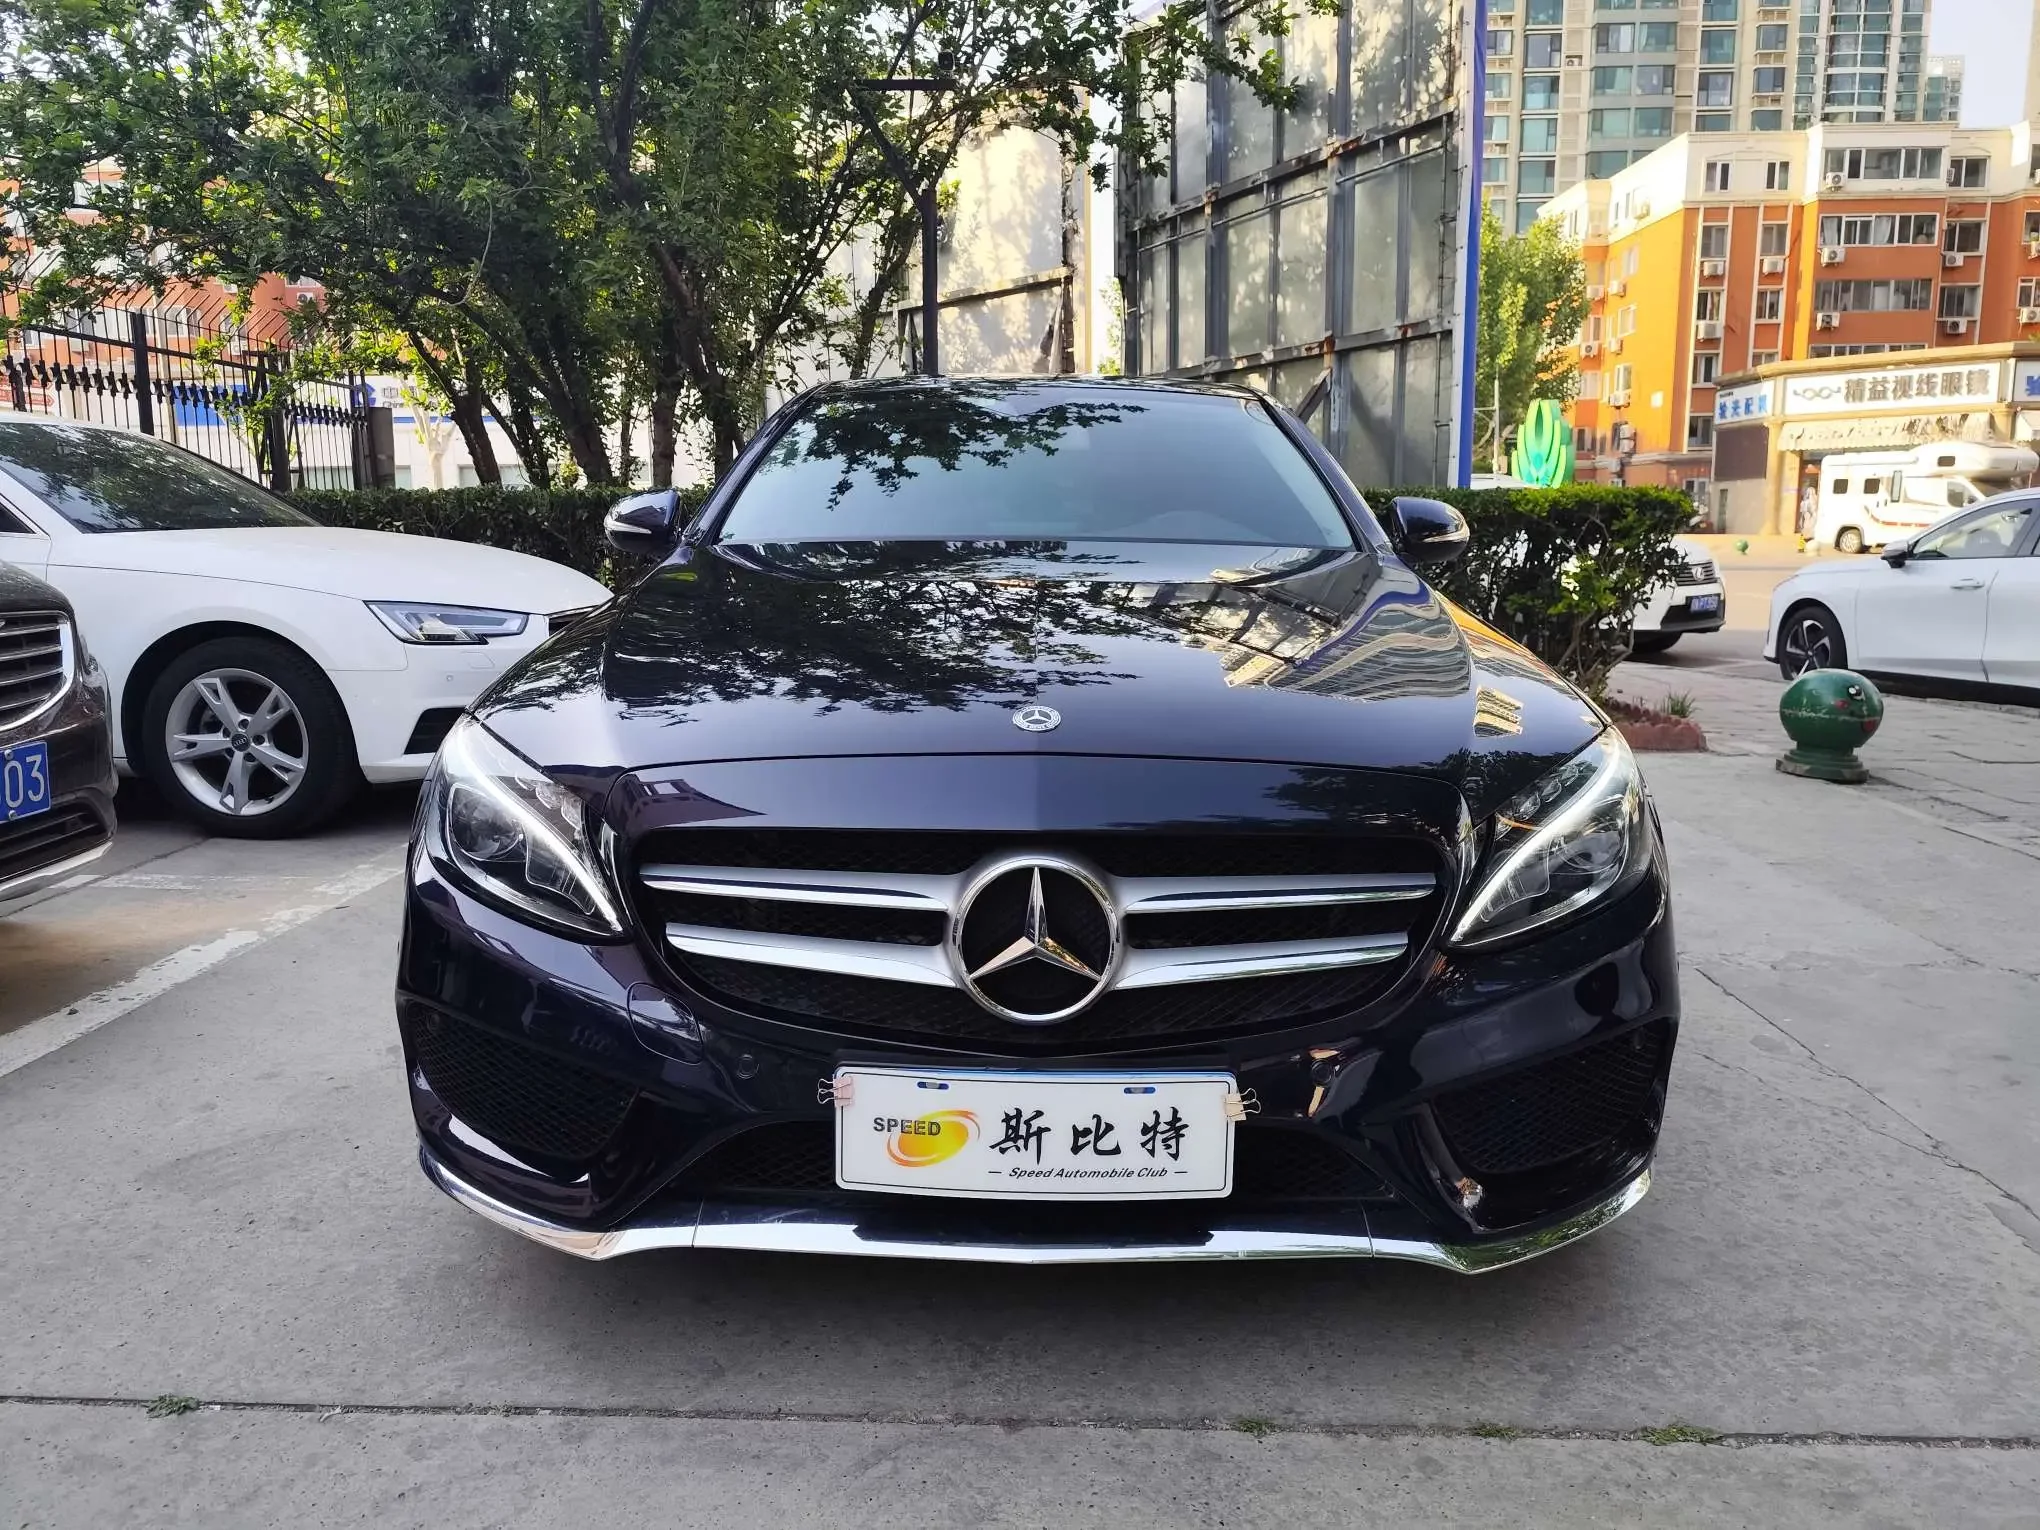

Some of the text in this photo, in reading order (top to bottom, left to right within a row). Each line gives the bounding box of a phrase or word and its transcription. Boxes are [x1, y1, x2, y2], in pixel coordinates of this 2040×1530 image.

[1844, 369, 1989, 403] 精益视线眼镜
[873, 1117, 941, 1137] SPEED
[989, 1106, 1190, 1165] 斯比特
[1009, 1167, 1168, 1179] Speed Automobile Club
